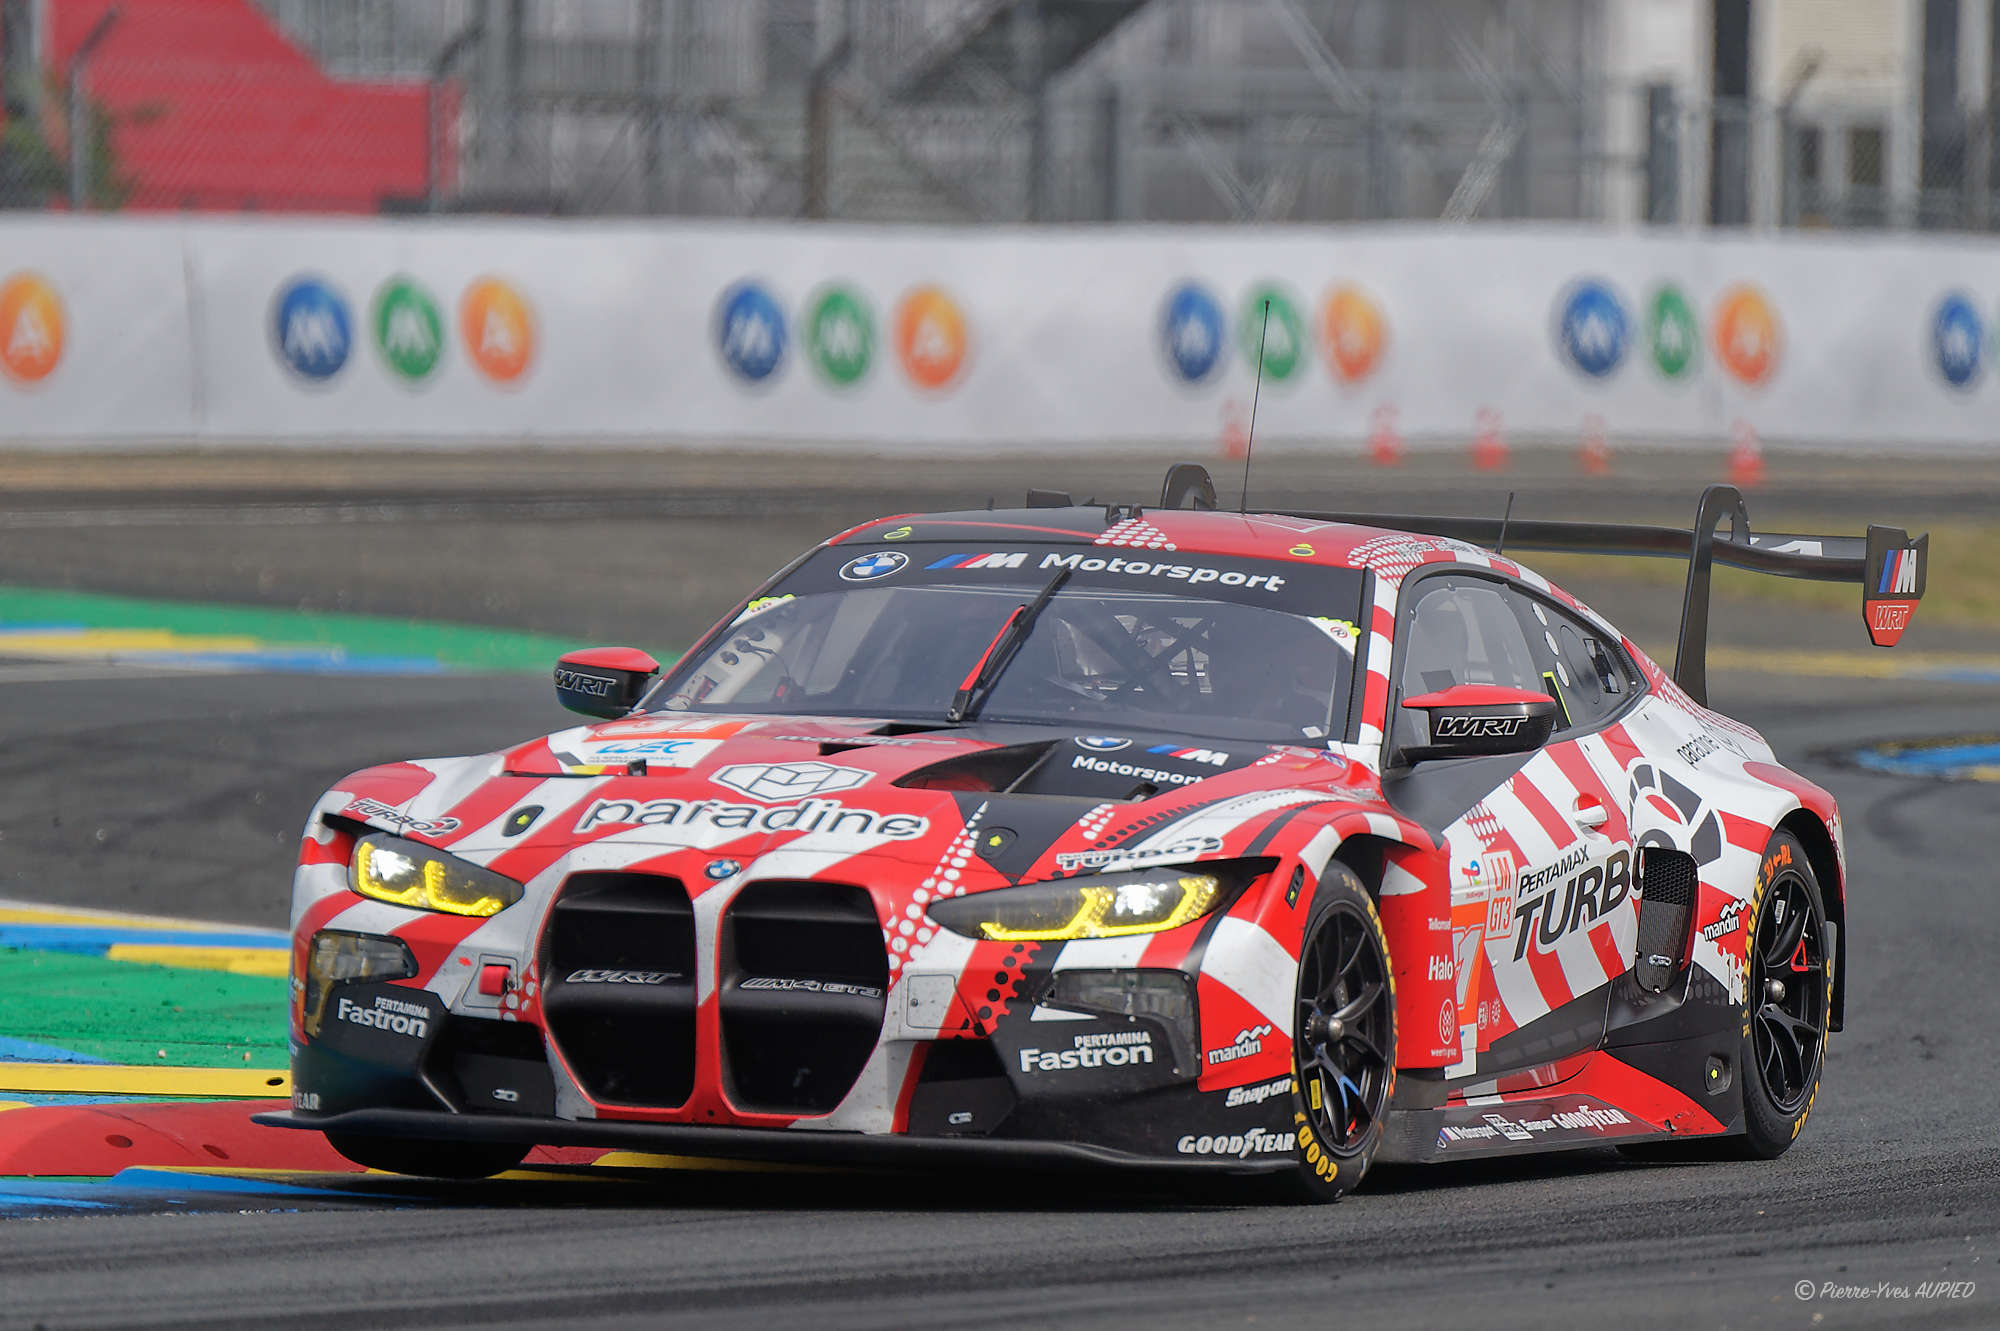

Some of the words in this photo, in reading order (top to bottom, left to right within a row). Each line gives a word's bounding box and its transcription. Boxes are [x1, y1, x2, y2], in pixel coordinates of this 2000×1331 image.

[1038, 553, 1286, 592] Motorsport
[1874, 605, 1909, 630] WRT
[554, 669, 617, 697] WRT
[1435, 716, 1528, 736] WRT
[1071, 755, 1204, 786] Motorsport
[575, 799, 929, 838] paradine
[1489, 856, 1511, 891] LM
[1517, 845, 1590, 898] PERTAMAX
[1489, 896, 1512, 933] GT3
[1513, 848, 1645, 963] TURB
[565, 969, 683, 985] WRT
[1428, 954, 1454, 981] Halo
[337, 997, 429, 1039] Fastron
[374, 995, 430, 1020] PERTAMINA
[1074, 1031, 1152, 1049] PERTAMINA
[1019, 1045, 1154, 1073] Fastron
[1225, 1078, 1292, 1108] Snap-on
[1552, 1105, 1631, 1132] GOODYEAR
[1176, 1127, 1296, 1159] GOODYEAR
